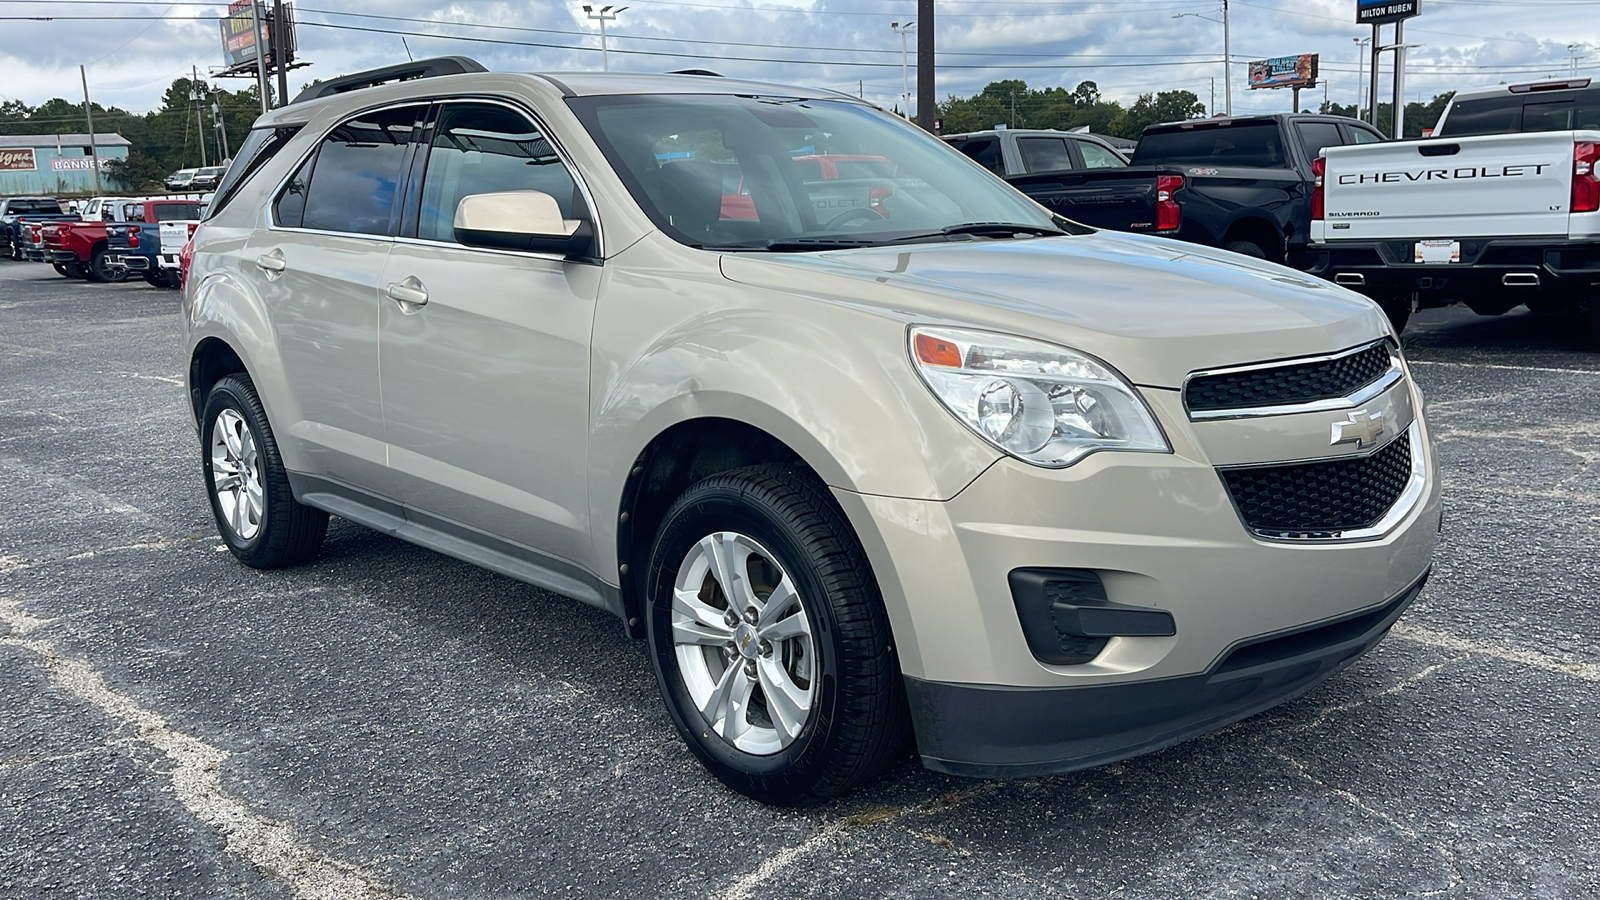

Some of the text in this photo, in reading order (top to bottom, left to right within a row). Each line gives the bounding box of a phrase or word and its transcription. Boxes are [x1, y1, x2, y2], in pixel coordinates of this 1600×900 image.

[1361, 3, 1412, 18] MILTON RUBEN
[1338, 163, 1551, 184] CHEVROLET
